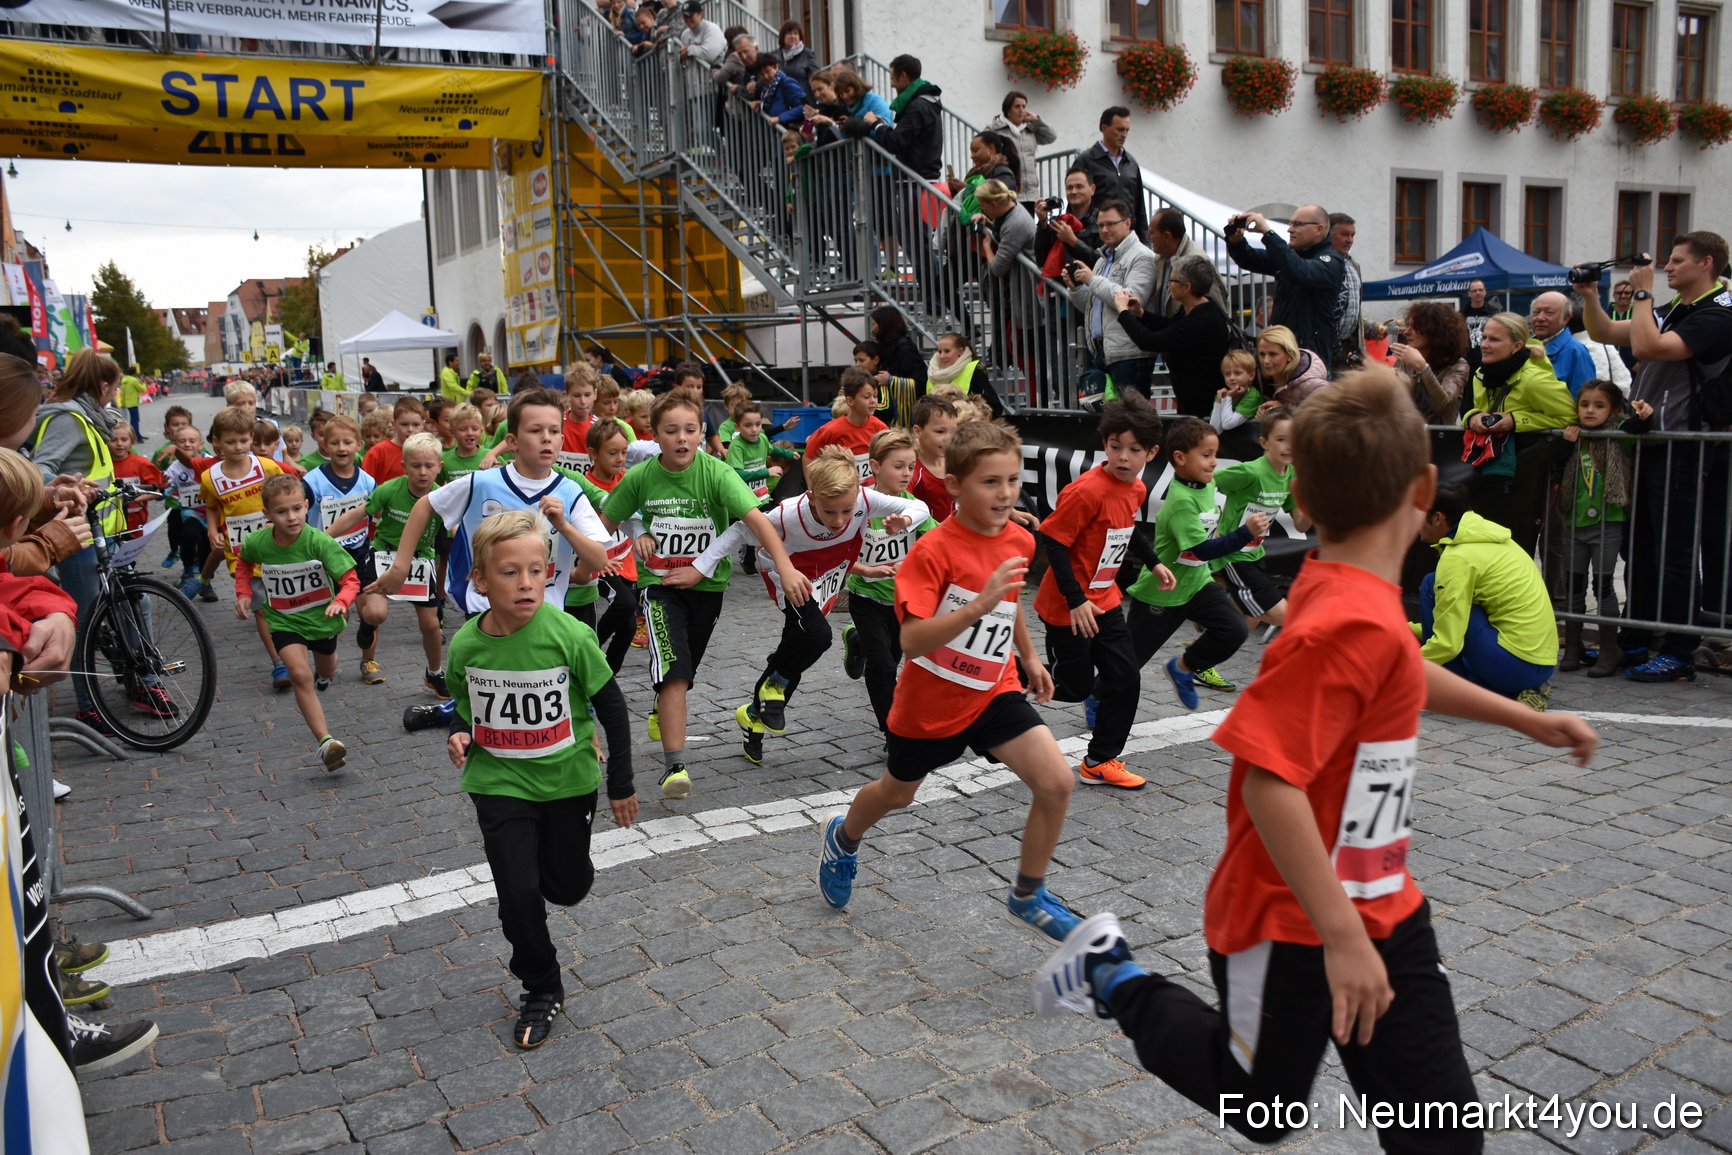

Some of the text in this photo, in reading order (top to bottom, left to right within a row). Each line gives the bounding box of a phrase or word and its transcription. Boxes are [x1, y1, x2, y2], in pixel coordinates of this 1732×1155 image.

[196, 2, 285, 20] VERBRAUCH.
[288, 9, 326, 22] MEHR
[329, 12, 416, 28] FAHRFREUDE.
[61, 87, 122, 100] Stadtlauf
[160, 70, 366, 121] START
[398, 104, 510, 117] Neumarkter Stadtlauf
[64, 129, 118, 141] Stadtlauf
[366, 140, 470, 151] Neumarkter Stadtlauf
[1387, 282, 1435, 296] Neumarkter
[269, 349, 278, 360] A
[645, 497, 689, 506] Neumarkter
[281, 567, 312, 575] Neumarkt
[289, 596, 311, 607] Marc
[652, 604, 678, 662] predator
[951, 655, 982, 676] Leon
[469, 675, 553, 689] PARTL Neumarkt
[477, 689, 564, 726] 7403
[1357, 757, 1402, 774] PARTL
